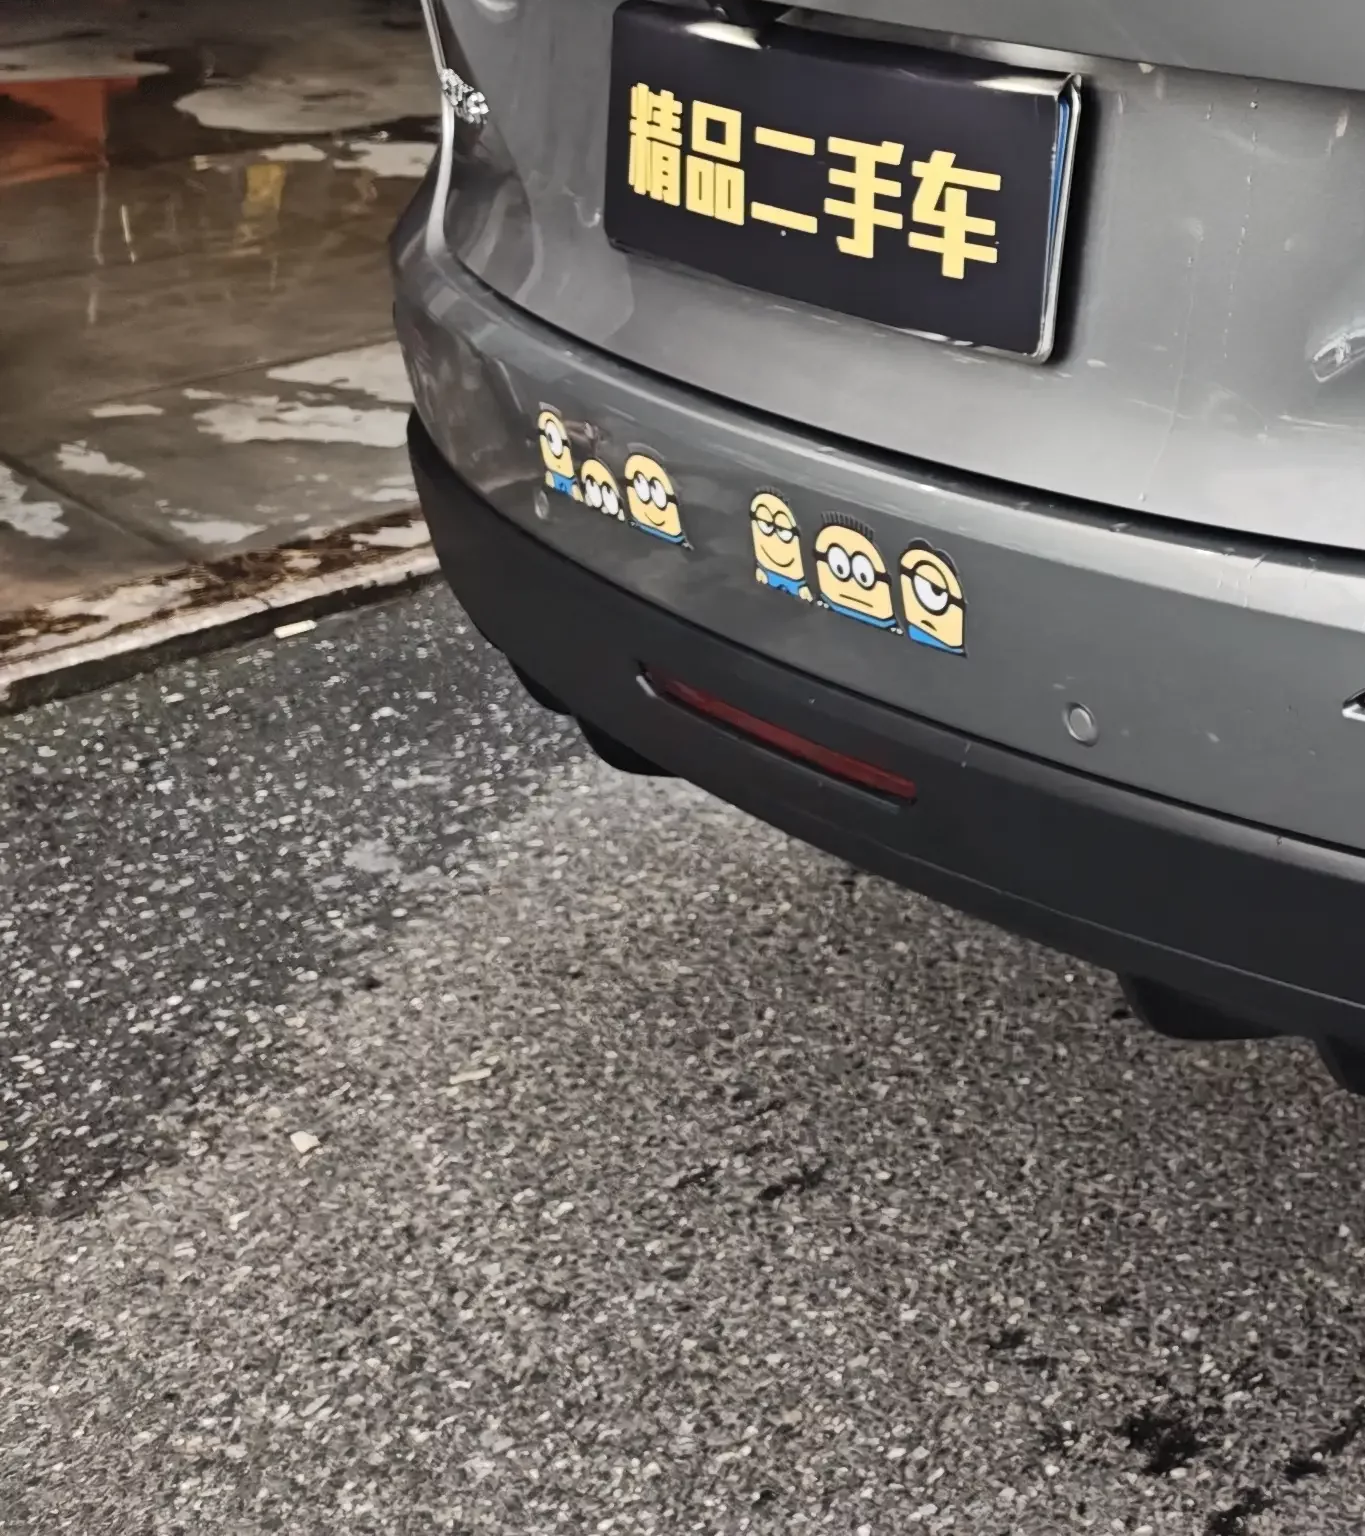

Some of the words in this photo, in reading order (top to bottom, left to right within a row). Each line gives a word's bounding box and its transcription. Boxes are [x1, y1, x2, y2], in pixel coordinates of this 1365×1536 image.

[627, 82, 1003, 281] 精品二手车
